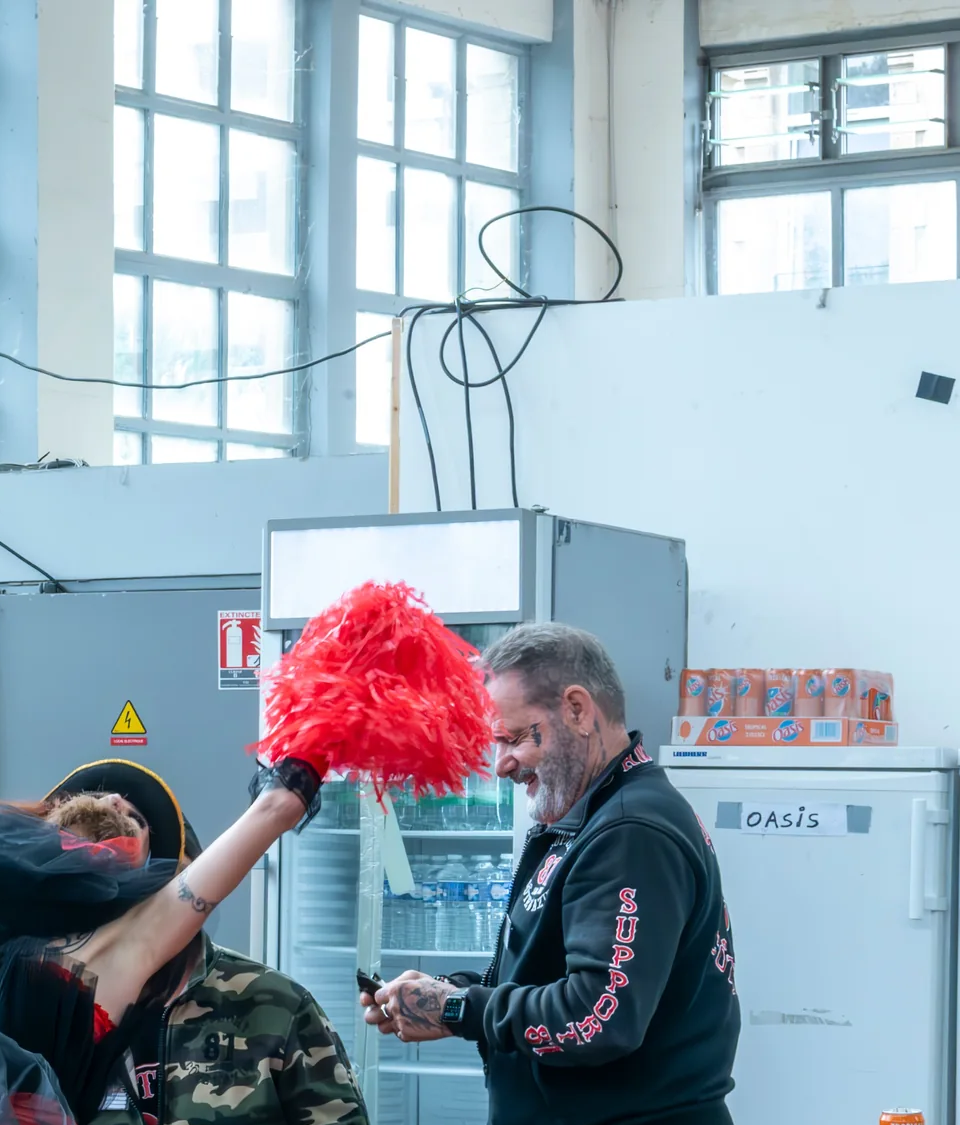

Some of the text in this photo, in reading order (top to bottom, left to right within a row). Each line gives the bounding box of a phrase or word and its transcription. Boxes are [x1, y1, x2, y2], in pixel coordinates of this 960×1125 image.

[707, 720, 739, 742] Oasis
[772, 720, 804, 743] Oasis
[556, 887, 639, 1045] SUPPORT
